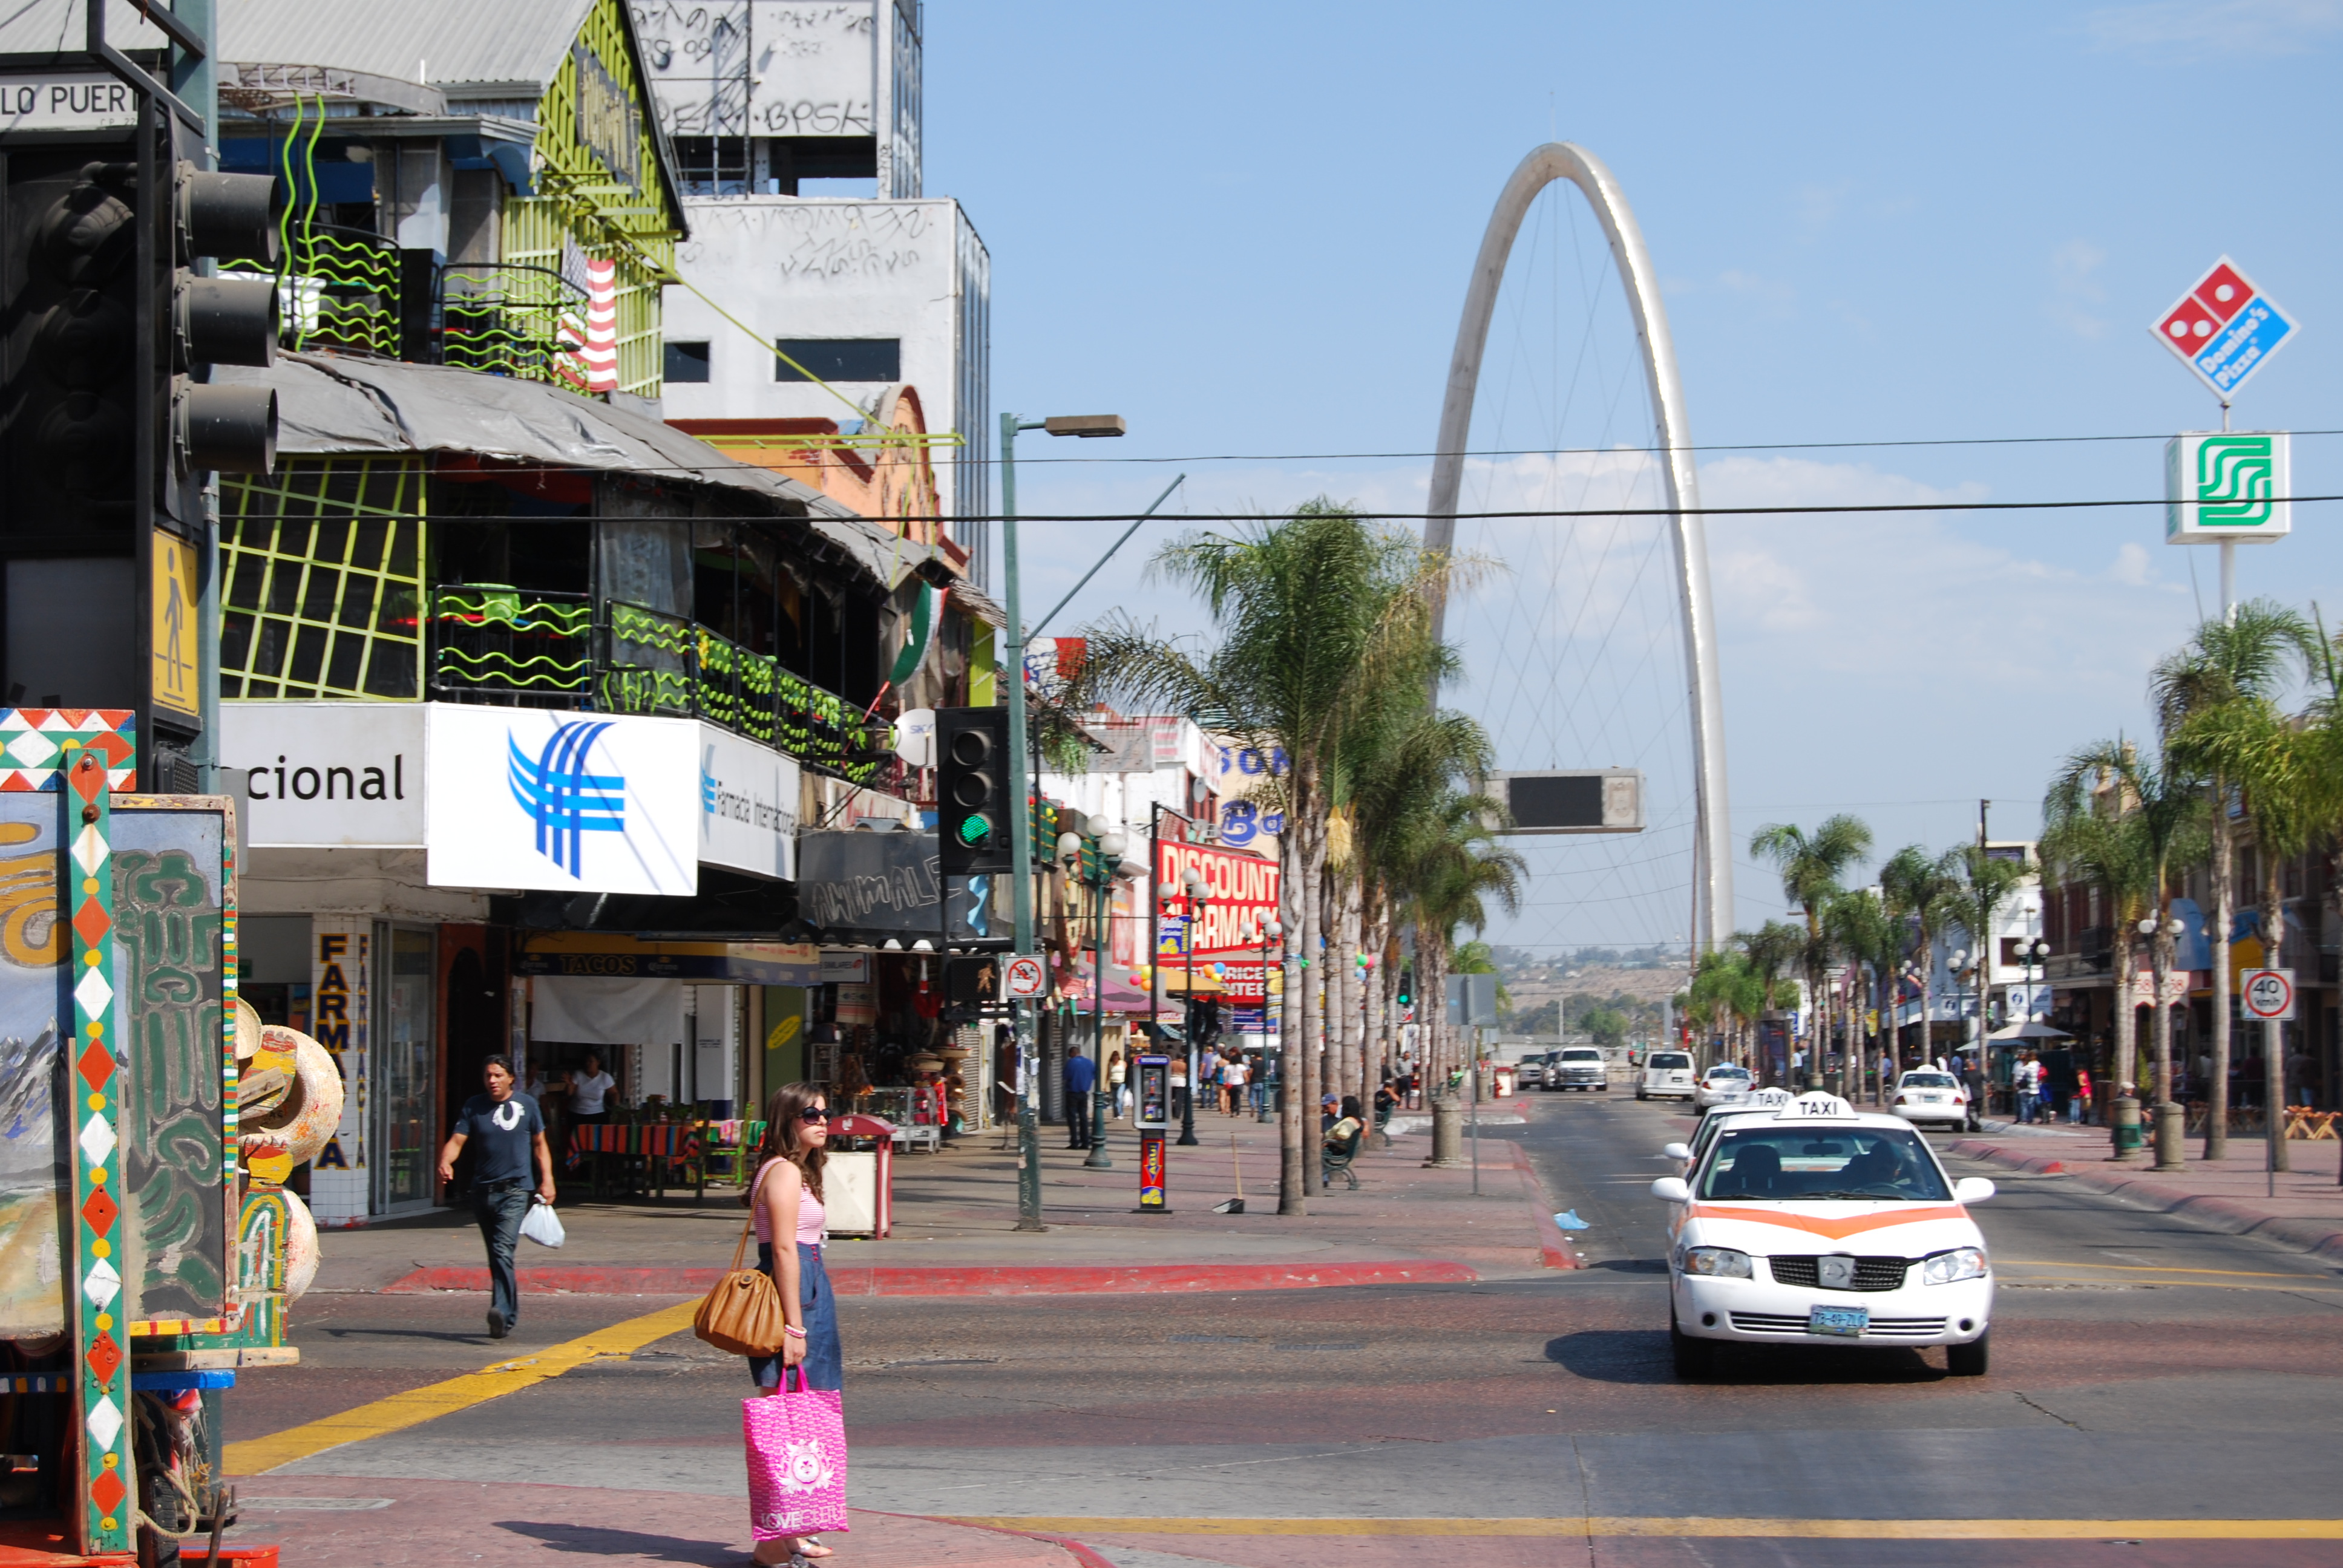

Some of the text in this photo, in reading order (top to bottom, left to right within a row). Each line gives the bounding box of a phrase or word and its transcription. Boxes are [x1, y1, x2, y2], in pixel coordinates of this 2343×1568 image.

[2200, 307, 2269, 374] Domino's
[2214, 345, 2261, 388] Pizza
[247, 754, 405, 800] cional
[718, 780, 750, 824] Farmacia
[1166, 903, 1279, 949] ARMAC
[560, 955, 637, 975] TACOS
[1222, 967, 1278, 980] RICE
[2253, 979, 2279, 994] 40
[314, 933, 351, 1169] FARMAA
[1798, 1101, 1838, 1116] TAXI
